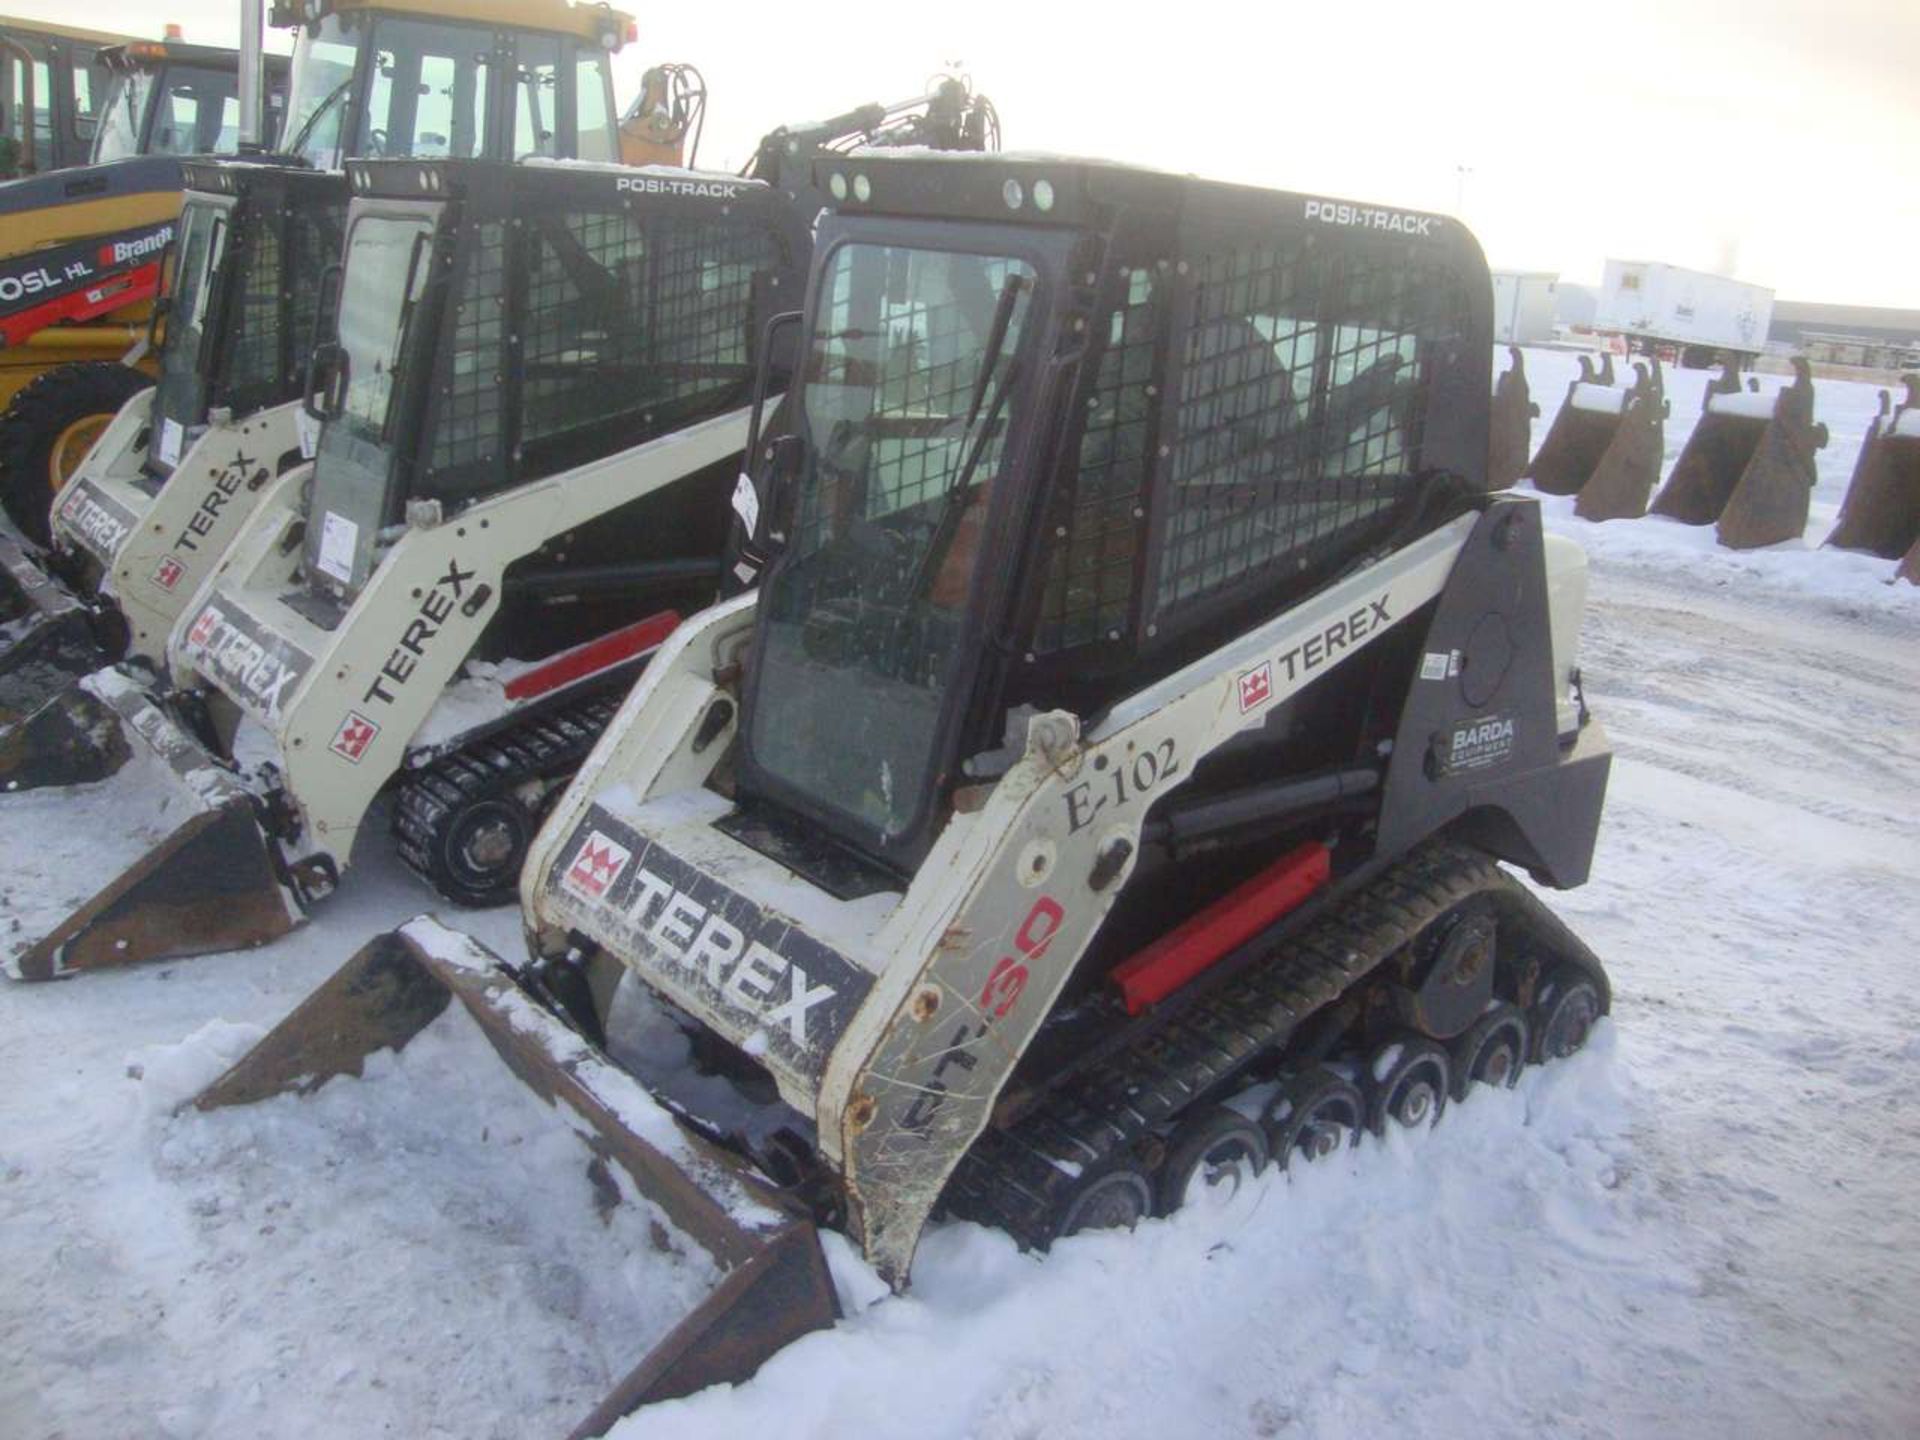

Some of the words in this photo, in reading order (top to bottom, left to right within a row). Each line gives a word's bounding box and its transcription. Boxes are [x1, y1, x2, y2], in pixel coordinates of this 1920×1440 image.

[616, 178, 736, 198] POSI-TRACK
[1304, 200, 1431, 236] POSI-TRACK
[113, 226, 174, 263] Brandt
[76, 498, 129, 553] TEREX
[174, 449, 257, 552] TEREX
[208, 618, 299, 719] TEREX
[363, 557, 476, 706] TEREX
[1278, 593, 1392, 681] TEREX
[1452, 719, 1514, 751] BARDA
[1062, 737, 1180, 836] E-102
[625, 867, 838, 1051] TEREX
